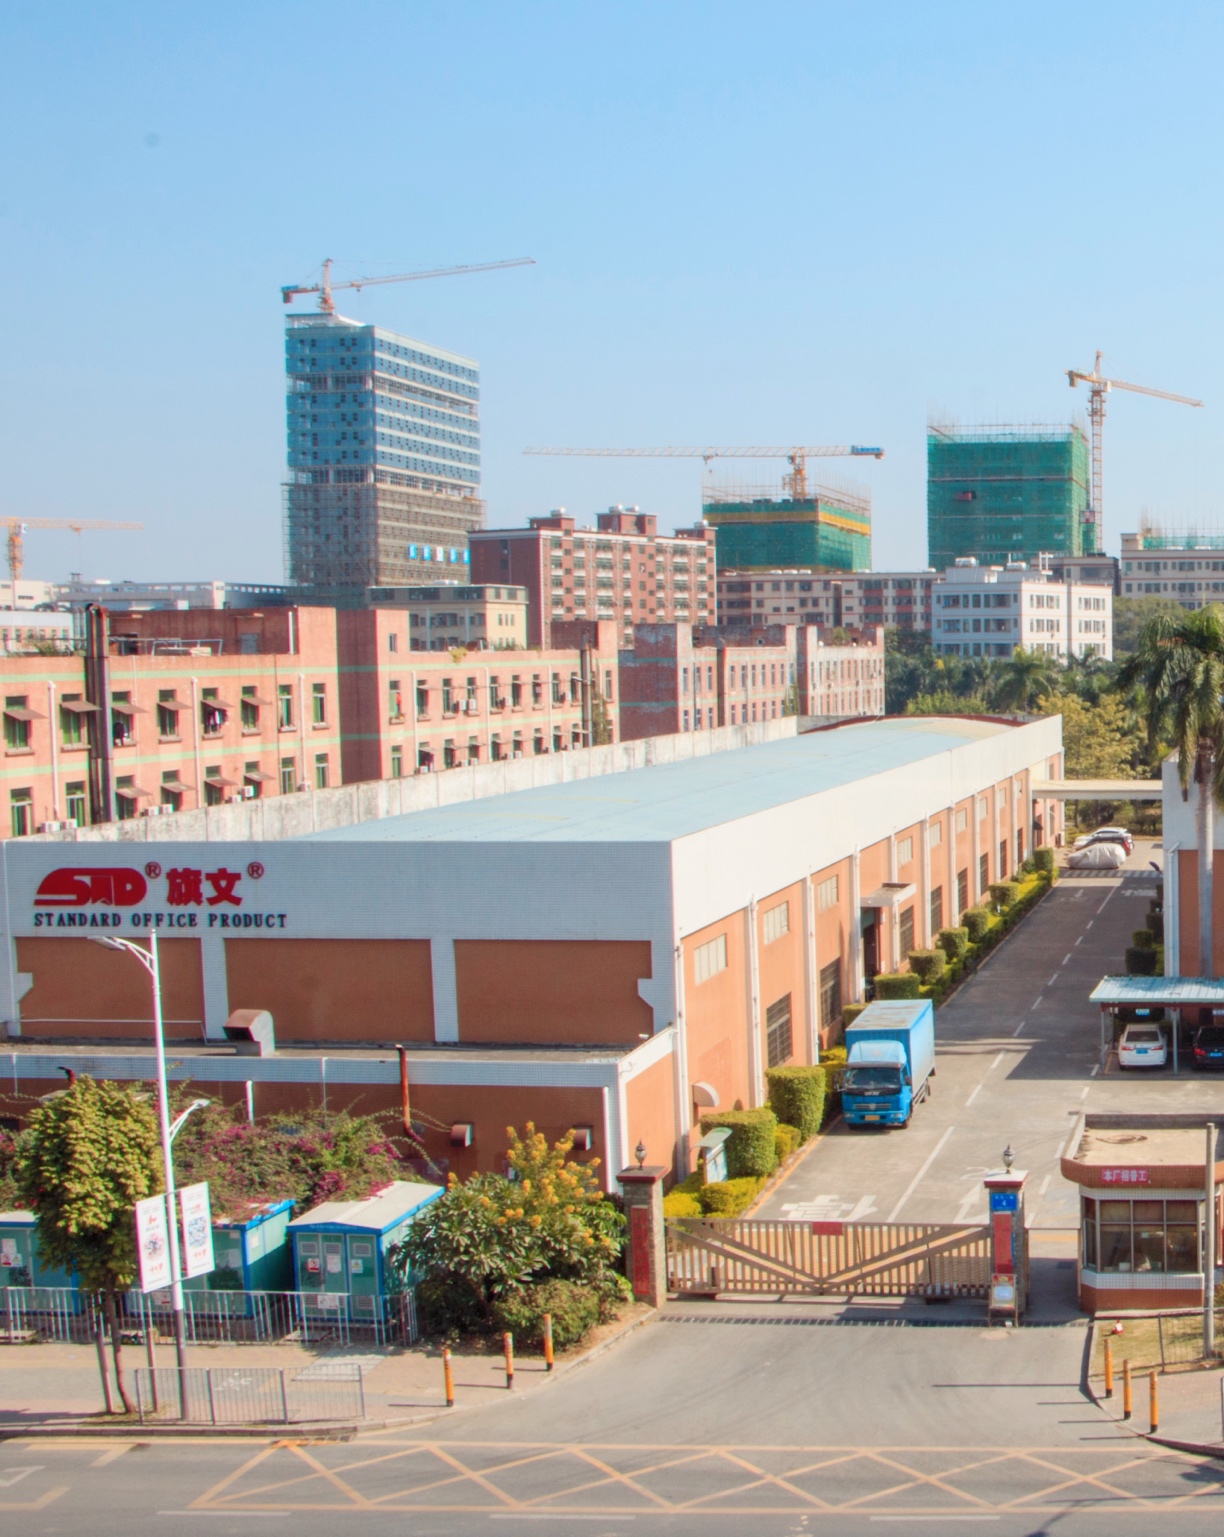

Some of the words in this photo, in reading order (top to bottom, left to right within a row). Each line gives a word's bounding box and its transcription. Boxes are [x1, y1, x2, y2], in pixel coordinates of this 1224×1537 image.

[166, 867, 243, 907] 旗文
[34, 912, 122, 927] STANDARD
[131, 912, 198, 928] OFFICE
[208, 912, 288, 929] PRODUCT
